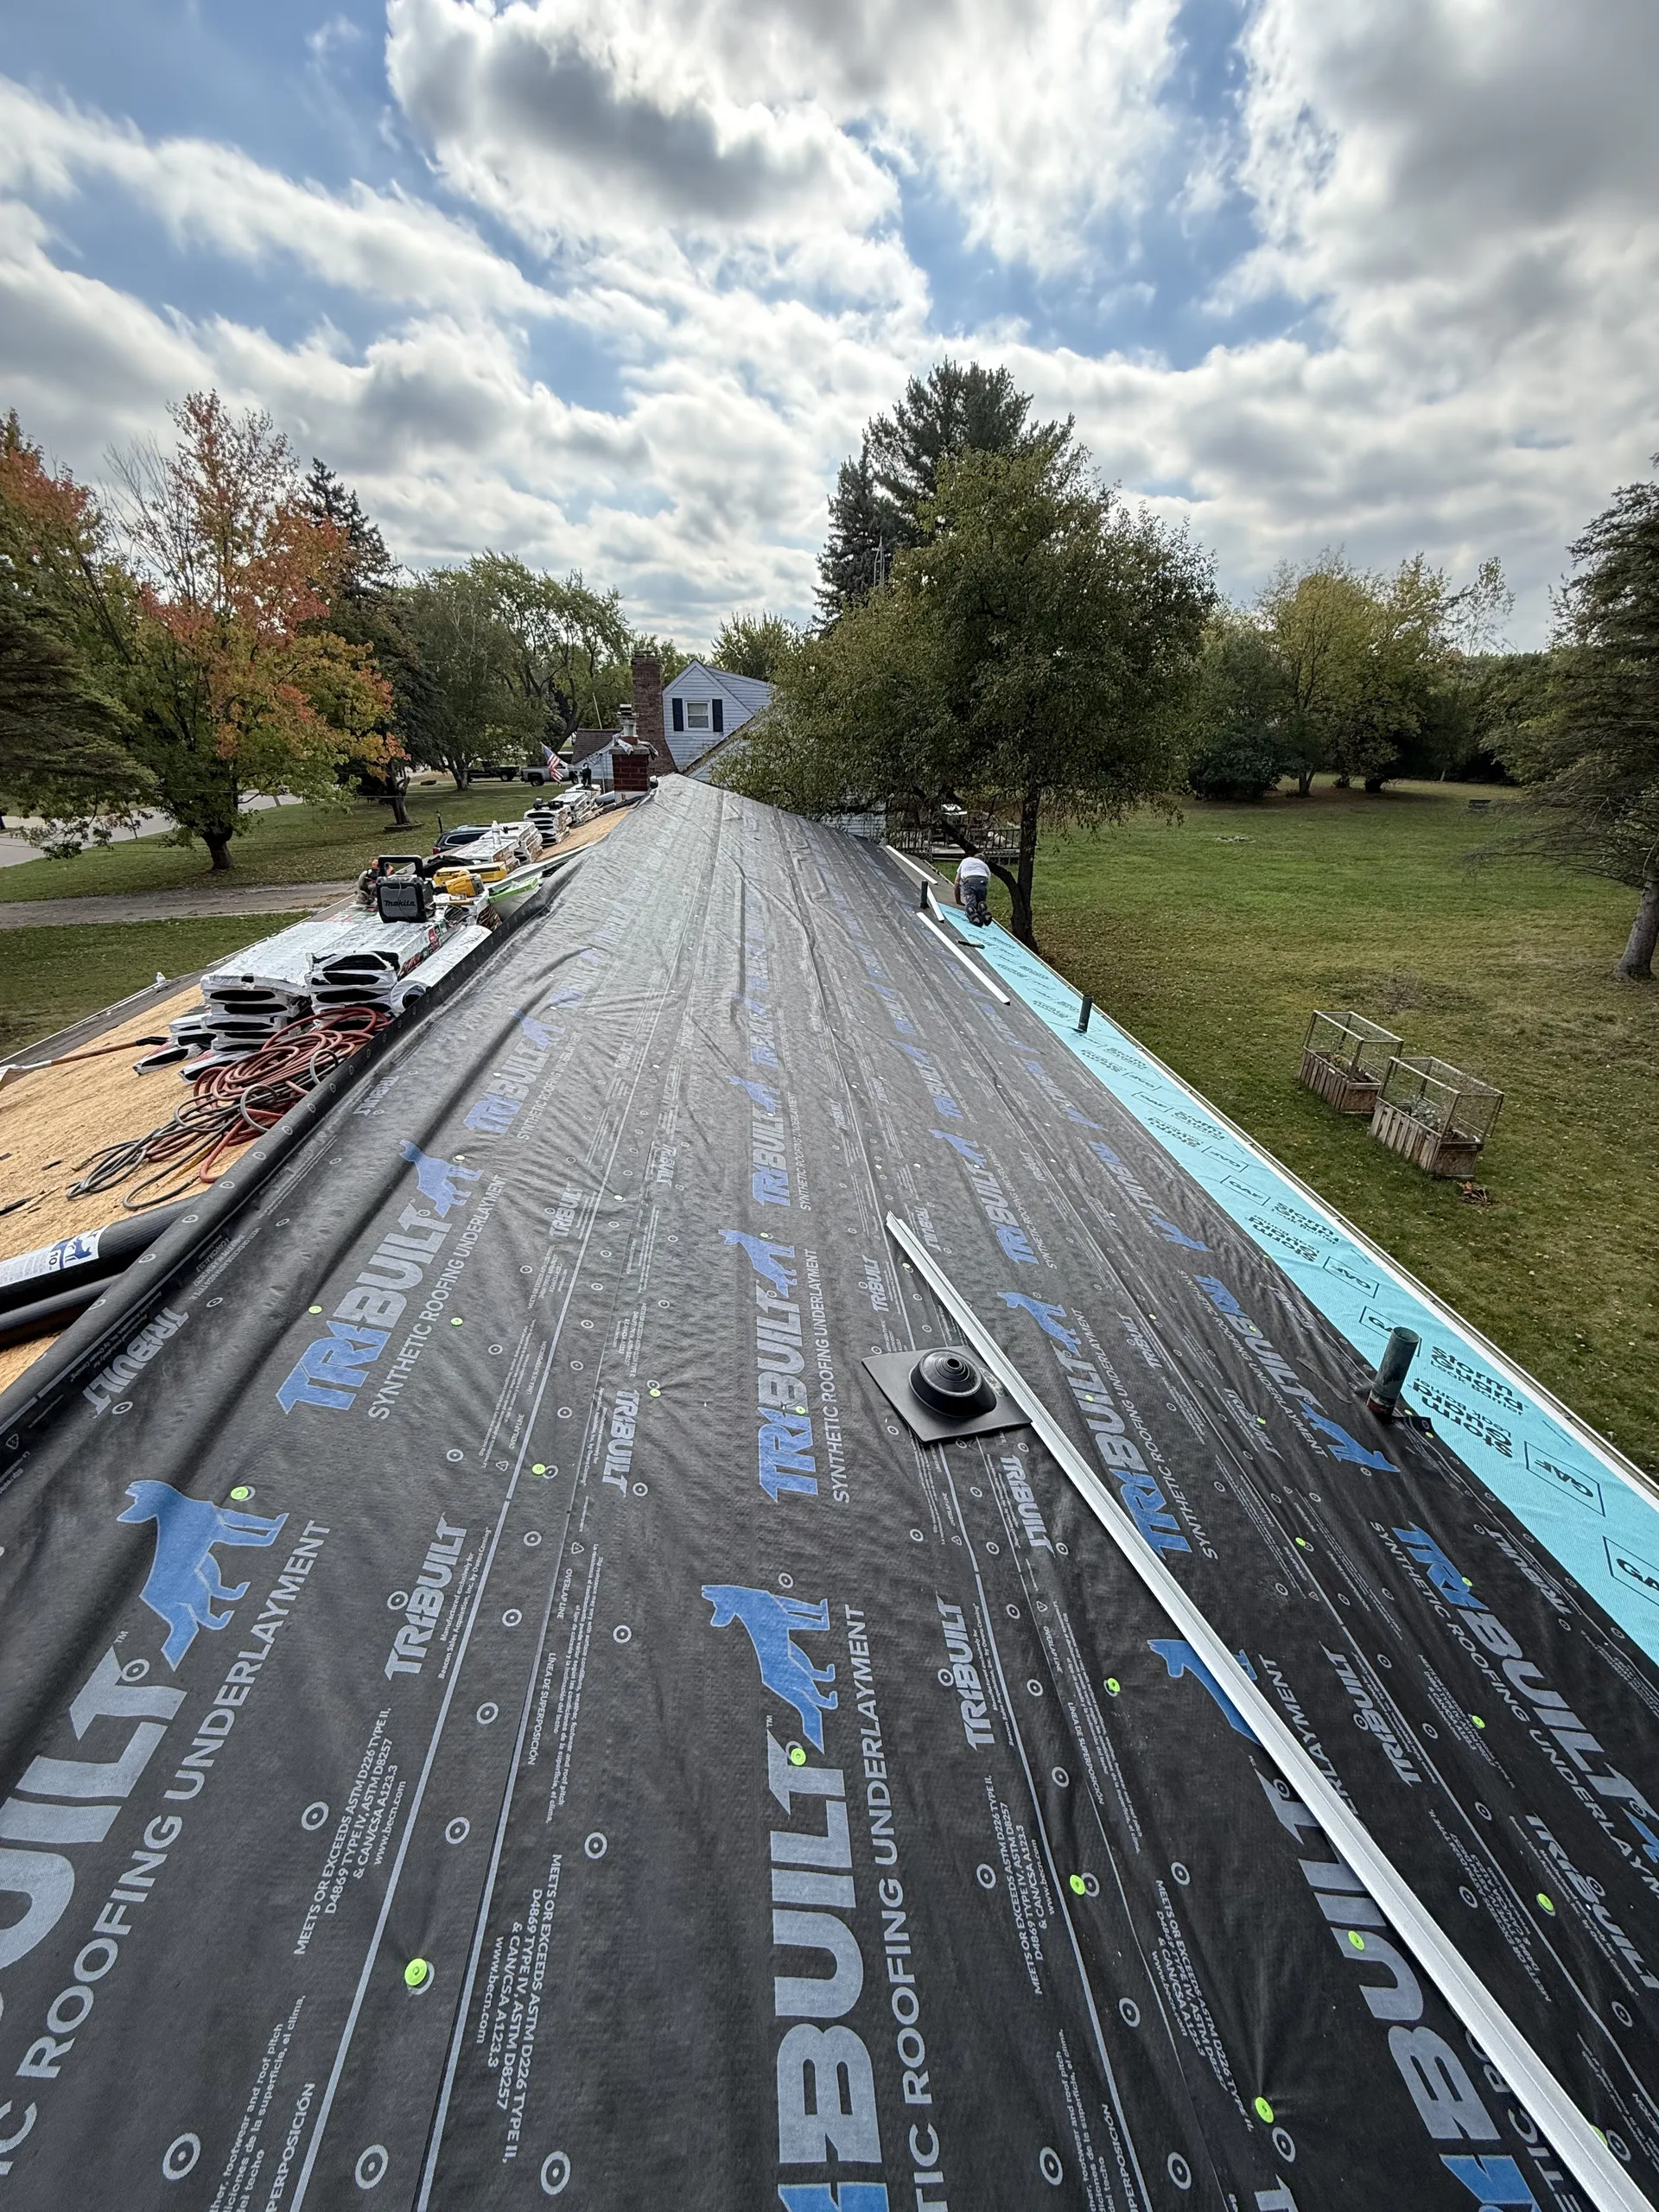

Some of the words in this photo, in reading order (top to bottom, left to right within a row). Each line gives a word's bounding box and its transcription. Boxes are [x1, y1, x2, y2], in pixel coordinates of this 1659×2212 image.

[465, 1041, 550, 1134] TRIBUILT
[517, 1100, 547, 1141] SYNTHETIC
[753, 1105, 790, 1206] TRIBUILT
[550, 1180, 584, 1239] TRIBUILT
[797, 1167, 811, 1211] SYNTHETIC
[963, 1157, 1039, 1264] TRIBUILT
[1229, 1180, 1264, 1200] GAF
[915, 1205, 941, 1253] TRIBUILT
[1277, 1202, 1334, 1236] Storm
[1027, 1223, 1057, 1270] SYNTHETIC
[1252, 1224, 1317, 1262] Storm
[368, 1323, 432, 1420] SYNTHETIC
[430, 1259, 465, 1323] ROOFING
[454, 1173, 507, 1257] UNDERLAYMENT
[804, 1249, 828, 1335] UNDERLAYMENT
[861, 1254, 890, 1313] TRIBUILT
[1331, 1265, 1371, 1289] GAF
[276, 1202, 453, 1414] TRIBUILT
[82, 1306, 190, 1416] TRIBUILT
[1071, 1307, 1128, 1396] UNDERLAYMENT
[1116, 1309, 1162, 1370] TRIBUILT
[1193, 1274, 1328, 1414] TRIBUILT
[815, 1338, 836, 1402] ROOFING
[1178, 1269, 1217, 1319] SYNTHETIC
[1213, 1317, 1252, 1361] ROOFING
[1248, 1363, 1329, 1459] UNDERLAYMENT
[1431, 1354, 1523, 1412] Guard
[1432, 1346, 1513, 1397] Storm
[756, 1282, 818, 1503] TRIBUILT
[1414, 1378, 1467, 1410] Barrier
[1430, 1360, 1467, 1384] Leak
[1471, 1384, 1524, 1416] Barrier
[1122, 1399, 1165, 1463] ROOFING
[1412, 1382, 1513, 1446] Guard
[1421, 1395, 1513, 1459] Storm
[1472, 1409, 1512, 1438] Leak
[602, 1389, 640, 1497] TRIBUILT
[821, 1406, 850, 1503] SYNTHETIC
[1052, 1344, 1192, 1560] TRIBUILT
[1534, 1459, 1594, 1497] GAF
[1000, 1455, 1056, 1558] TRIBUILT
[1158, 1464, 1218, 1560] SYNTHETIC
[384, 1510, 467, 1680] TRIBUILT
[560, 1567, 572, 1602] OVERLAP
[1616, 1558, 1659, 1590] GA
[556, 1602, 566, 1619] LINE
[1370, 1521, 1451, 1619] SYNTHETIC
[1448, 1620, 1532, 1723] ROOFING
[544, 1652, 556, 1676] LÍNEA
[936, 1594, 995, 1751] TRIBUILT
[1043, 1625, 1057, 1656] OVERLAP
[1052, 1656, 1063, 1673] LINE
[1391, 1522, 1659, 1821] TRIBUILT
[542, 1677, 550, 1690] DE
[367, 1719, 386, 1748] TYPE
[378, 1708, 391, 1717] II,
[527, 1690, 549, 1764] SUPERPOSICIÓN
[845, 1604, 899, 1865] UNDERLAYMENT
[1066, 1701, 1079, 1725] LÍNEA
[1074, 1725, 1083, 1736] DE
[1319, 1640, 1422, 1788] TRIBUILT
[357, 1749, 375, 1778] D226
[372, 1738, 392, 1775] D8257
[983, 1775, 992, 1783] II,
[1077, 1737, 1104, 1804] SUPERPOSICIÓN
[0, 1646, 188, 1969] UILT
[16, 1815, 183, 2078] ROOFING
[164, 1520, 332, 1800] UNDERLAYMENT
[345, 1779, 365, 1815] ASTM
[360, 1776, 380, 1811] ASTM
[377, 1765, 397, 1807] A123.3
[986, 1785, 998, 1812] TYPE
[353, 1812, 370, 1828] IV,
[357, 1808, 384, 1865] CAN/CSA
[373, 1781, 406, 1865] www.becn.com
[991, 1813, 1005, 1840] D226
[999, 1802, 1014, 1834] D8257
[321, 1815, 352, 1877] EXCEEDS
[340, 1829, 362, 1866] TYPE
[998, 1841, 1013, 1874] ASTM
[1007, 1836, 1022, 1868] ASTM
[1015, 1824, 1032, 1861] A123.3
[314, 1879, 330, 1902] OR
[323, 1867, 348, 1913] D4869
[353, 1867, 365, 1878] &
[546, 1853, 562, 1897] MEETS
[1015, 1870, 1027, 1885] IV,
[1025, 1863, 1044, 1917] CAN/CSA
[1031, 1839, 1054, 1915] www.becn.com
[526, 1888, 543, 1933] D4869
[542, 1899, 555, 1921] OR
[1006, 1875, 1025, 1929] EXCEEDS
[1020, 1887, 1033, 1918] TYPE
[1038, 1919, 1046, 1929] &
[293, 1904, 321, 1955] MEETS
[512, 1921, 522, 1932] &
[1019, 1931, 1029, 1950] OR
[1027, 1920, 1043, 1960] D4869
[498, 1935, 520, 2006] CAN/CSA
[518, 1936, 535, 1974] TYPE
[531, 1923, 551, 1990] EXCEEDS
[1023, 1952, 1042, 1994] MEETS
[476, 1936, 504, 2043] www.becn.com
[516, 1977, 528, 1993] IV,
[875, 1878, 933, 2104] ROOFING
[487, 2008, 506, 2067] A123.3
[505, 2000, 524, 2049] ASTM
[523, 1993, 540, 2040] ASTM
[497, 2052, 516, 2109] D8257
[515, 2044, 532, 2089] D226
[507, 2092, 525, 2139] TYPE
[501, 2136, 518, 2163] II,
